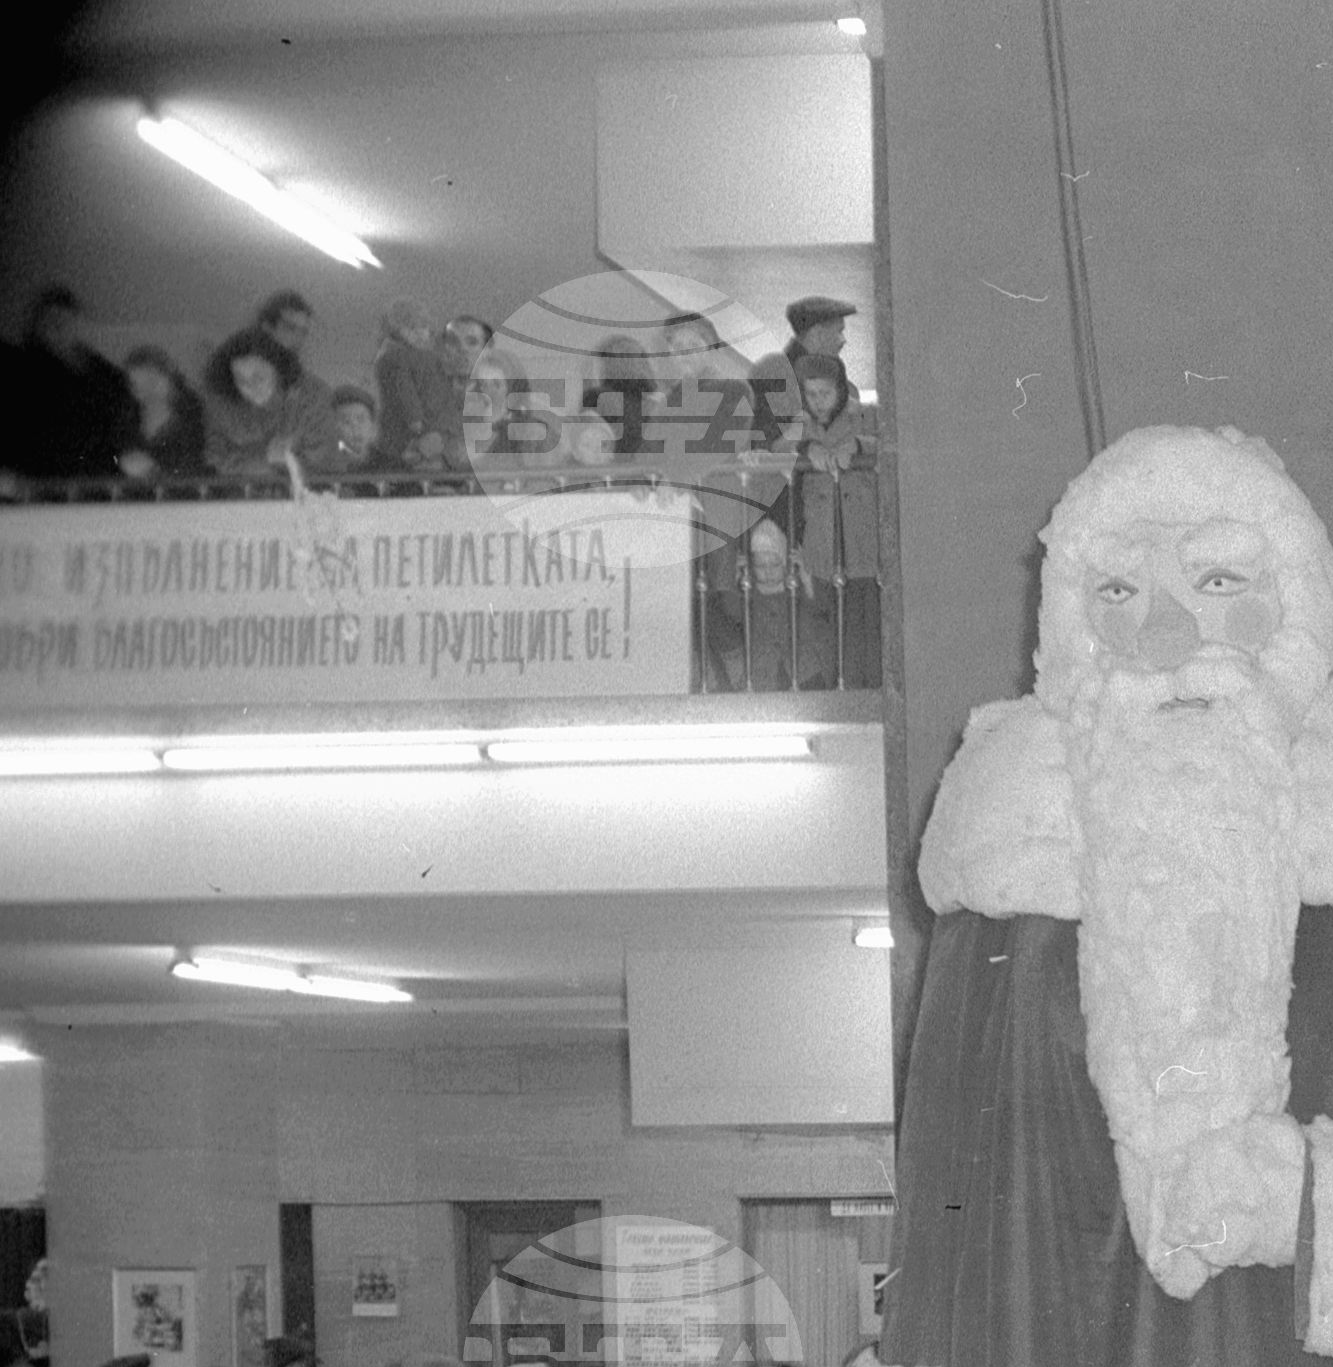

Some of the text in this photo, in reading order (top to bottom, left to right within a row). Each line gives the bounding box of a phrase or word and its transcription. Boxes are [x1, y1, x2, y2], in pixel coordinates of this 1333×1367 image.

[372, 519, 617, 590] ПЕТИЛЕТКАТА,
[372, 614, 404, 666] НА
[417, 609, 574, 678] ТРУДЕЩИТЕ
